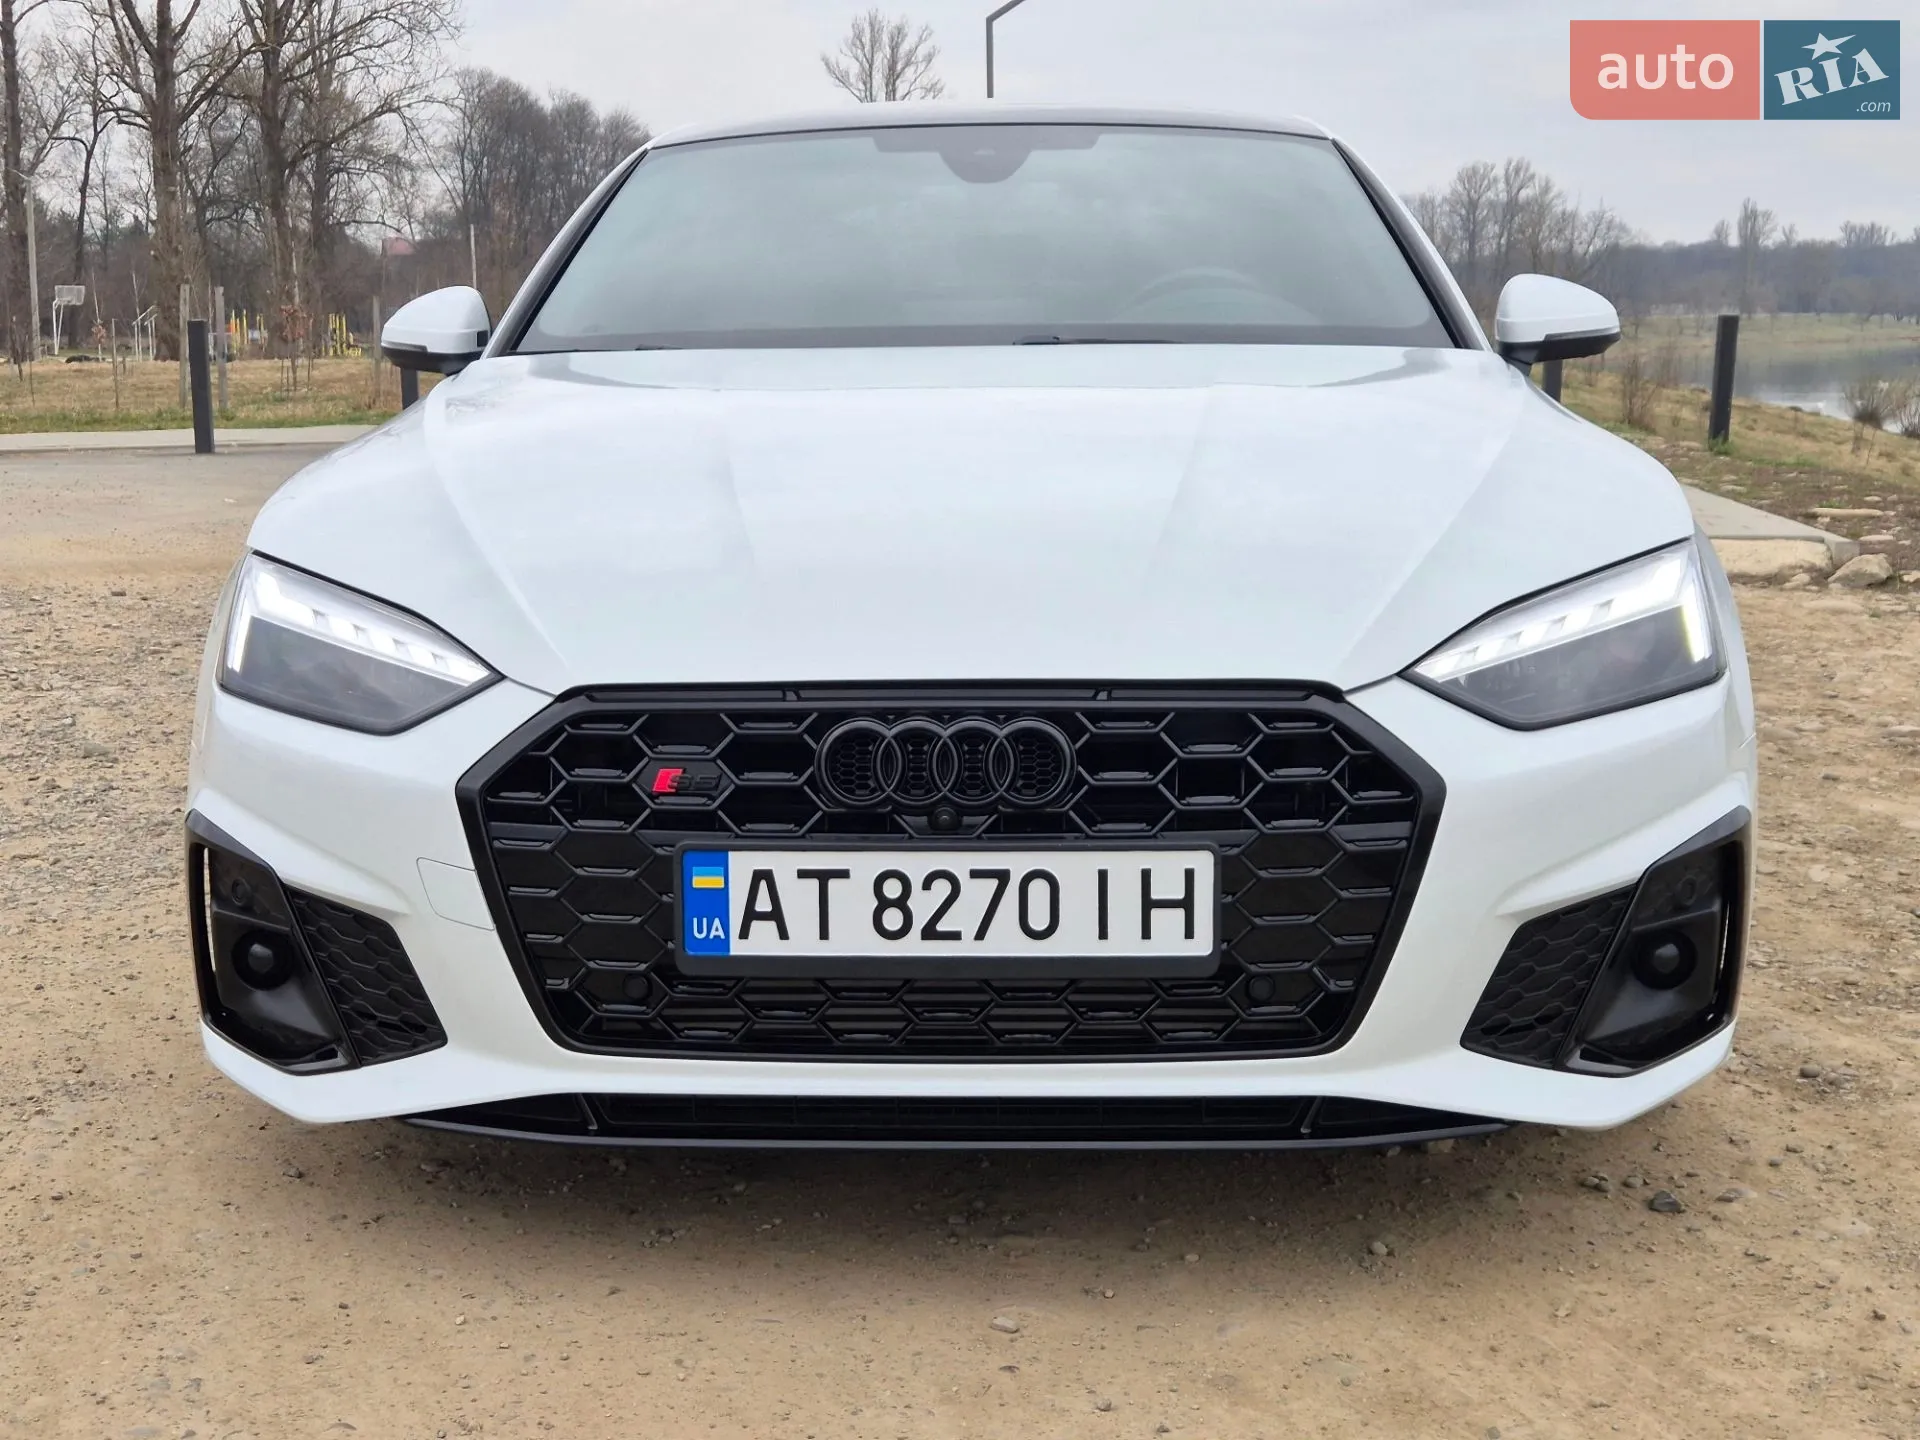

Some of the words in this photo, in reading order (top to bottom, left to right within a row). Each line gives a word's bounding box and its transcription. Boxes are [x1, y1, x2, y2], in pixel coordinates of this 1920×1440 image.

[692, 917, 726, 940] UA
[738, 868, 851, 941] AT
[872, 868, 1061, 941] 8270
